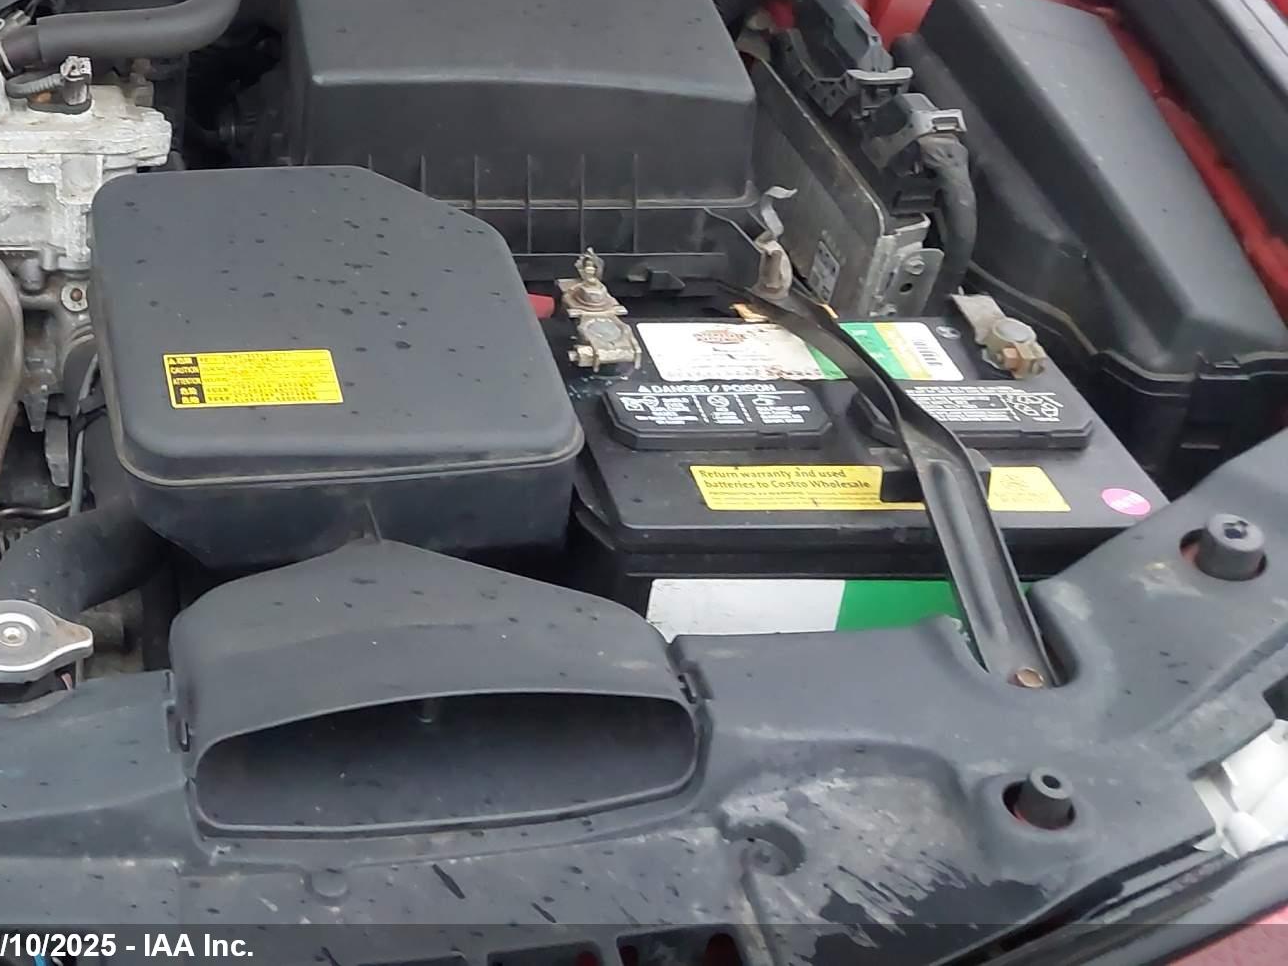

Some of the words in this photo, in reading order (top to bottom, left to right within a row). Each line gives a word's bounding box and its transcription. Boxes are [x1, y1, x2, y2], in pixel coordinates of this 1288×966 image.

[650, 384, 711, 393] DANGER
[722, 384, 777, 392] POISON
[699, 469, 738, 479] Return
[739, 470, 792, 480] warranty
[794, 469, 817, 478] and
[818, 469, 846, 478] used
[705, 479, 755, 489] batteries
[757, 480, 769, 488] to
[770, 479, 809, 489] Costco
[810, 479, 871, 489] Wholesale
